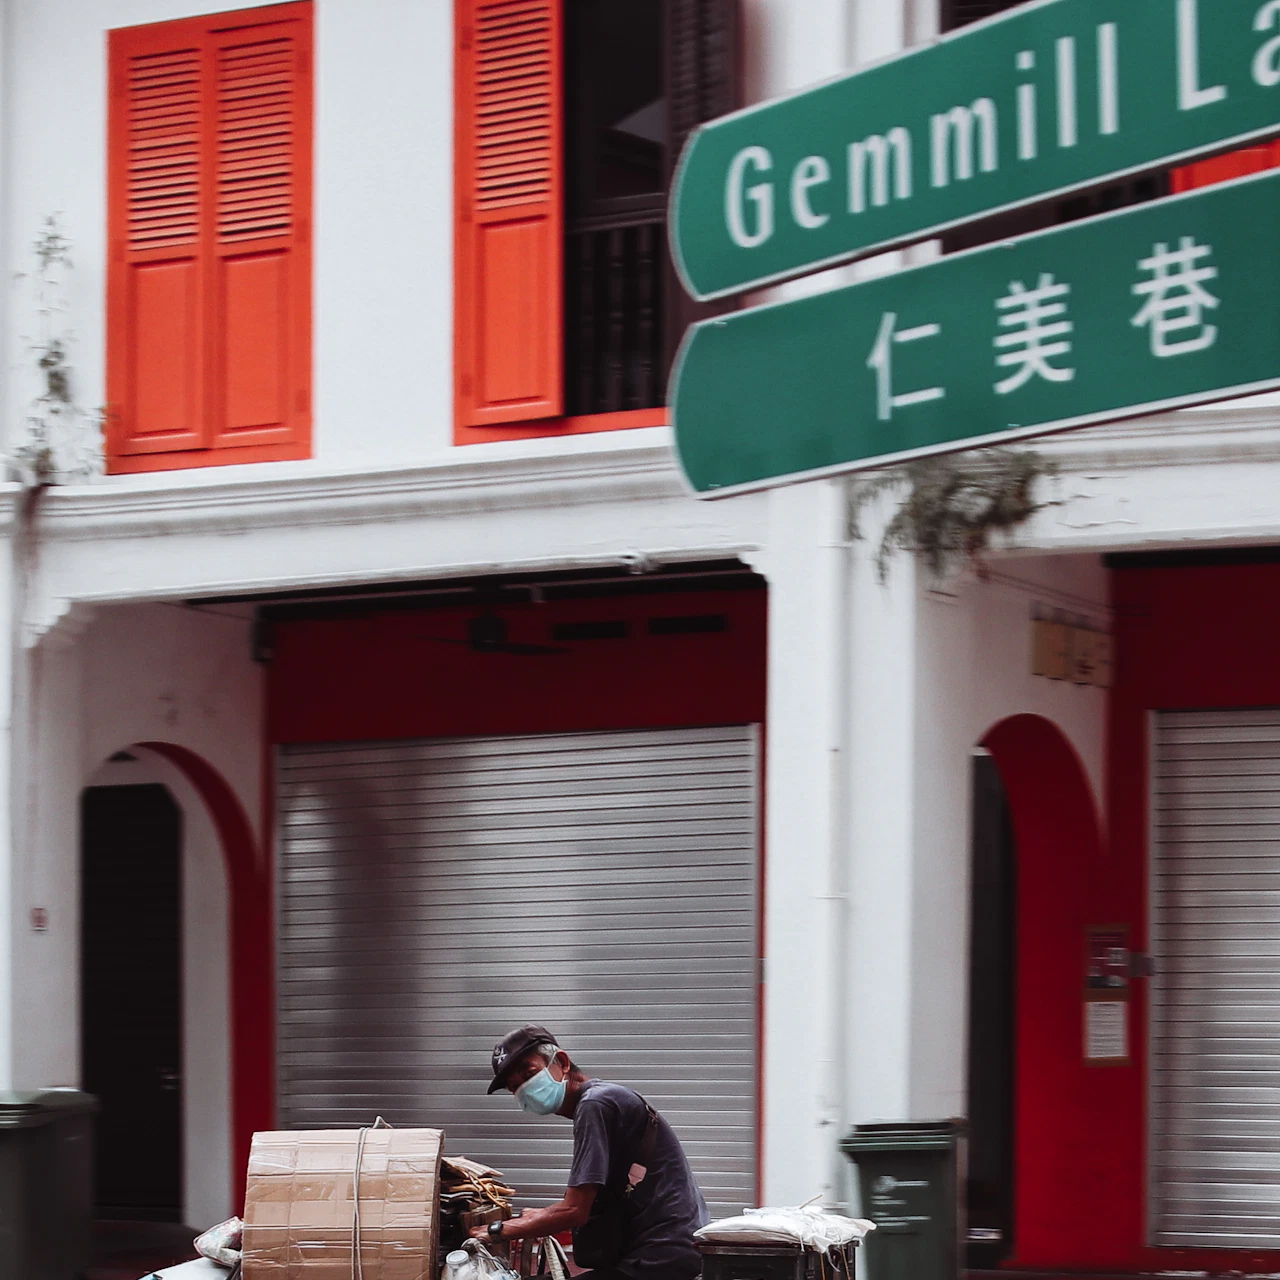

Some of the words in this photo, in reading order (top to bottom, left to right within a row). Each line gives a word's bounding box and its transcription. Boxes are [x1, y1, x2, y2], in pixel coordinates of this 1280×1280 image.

[725, 22, 1119, 248] Gemmill
[866, 236, 1220, 420] 仁美巷
